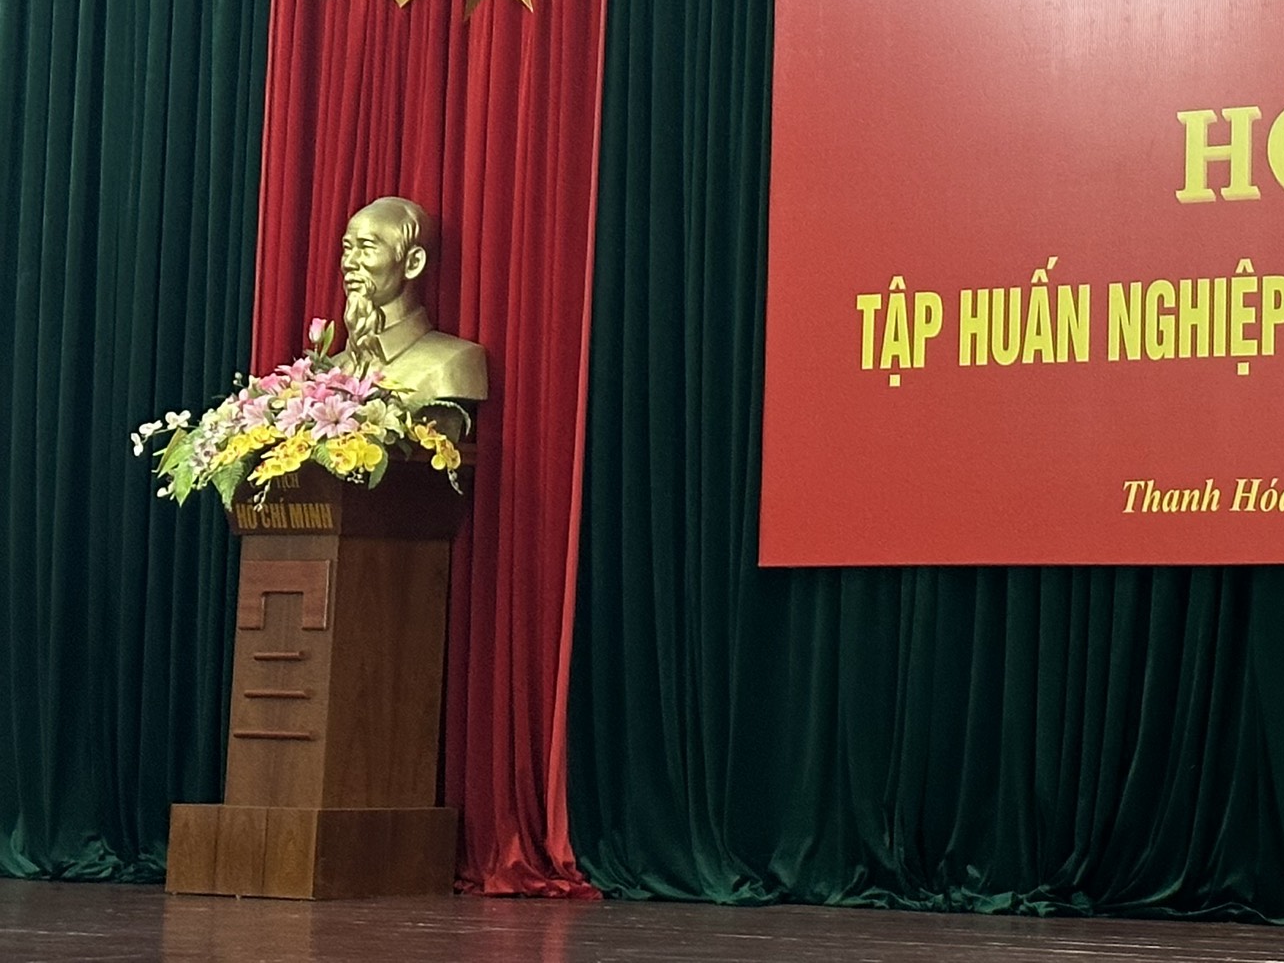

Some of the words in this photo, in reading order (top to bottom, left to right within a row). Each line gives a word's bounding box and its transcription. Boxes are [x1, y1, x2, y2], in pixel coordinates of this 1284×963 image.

[856, 275, 944, 387] TẬP
[959, 256, 1091, 367] HUẤN
[1122, 479, 1220, 514] Thanh
[288, 502, 334, 529] MINH
